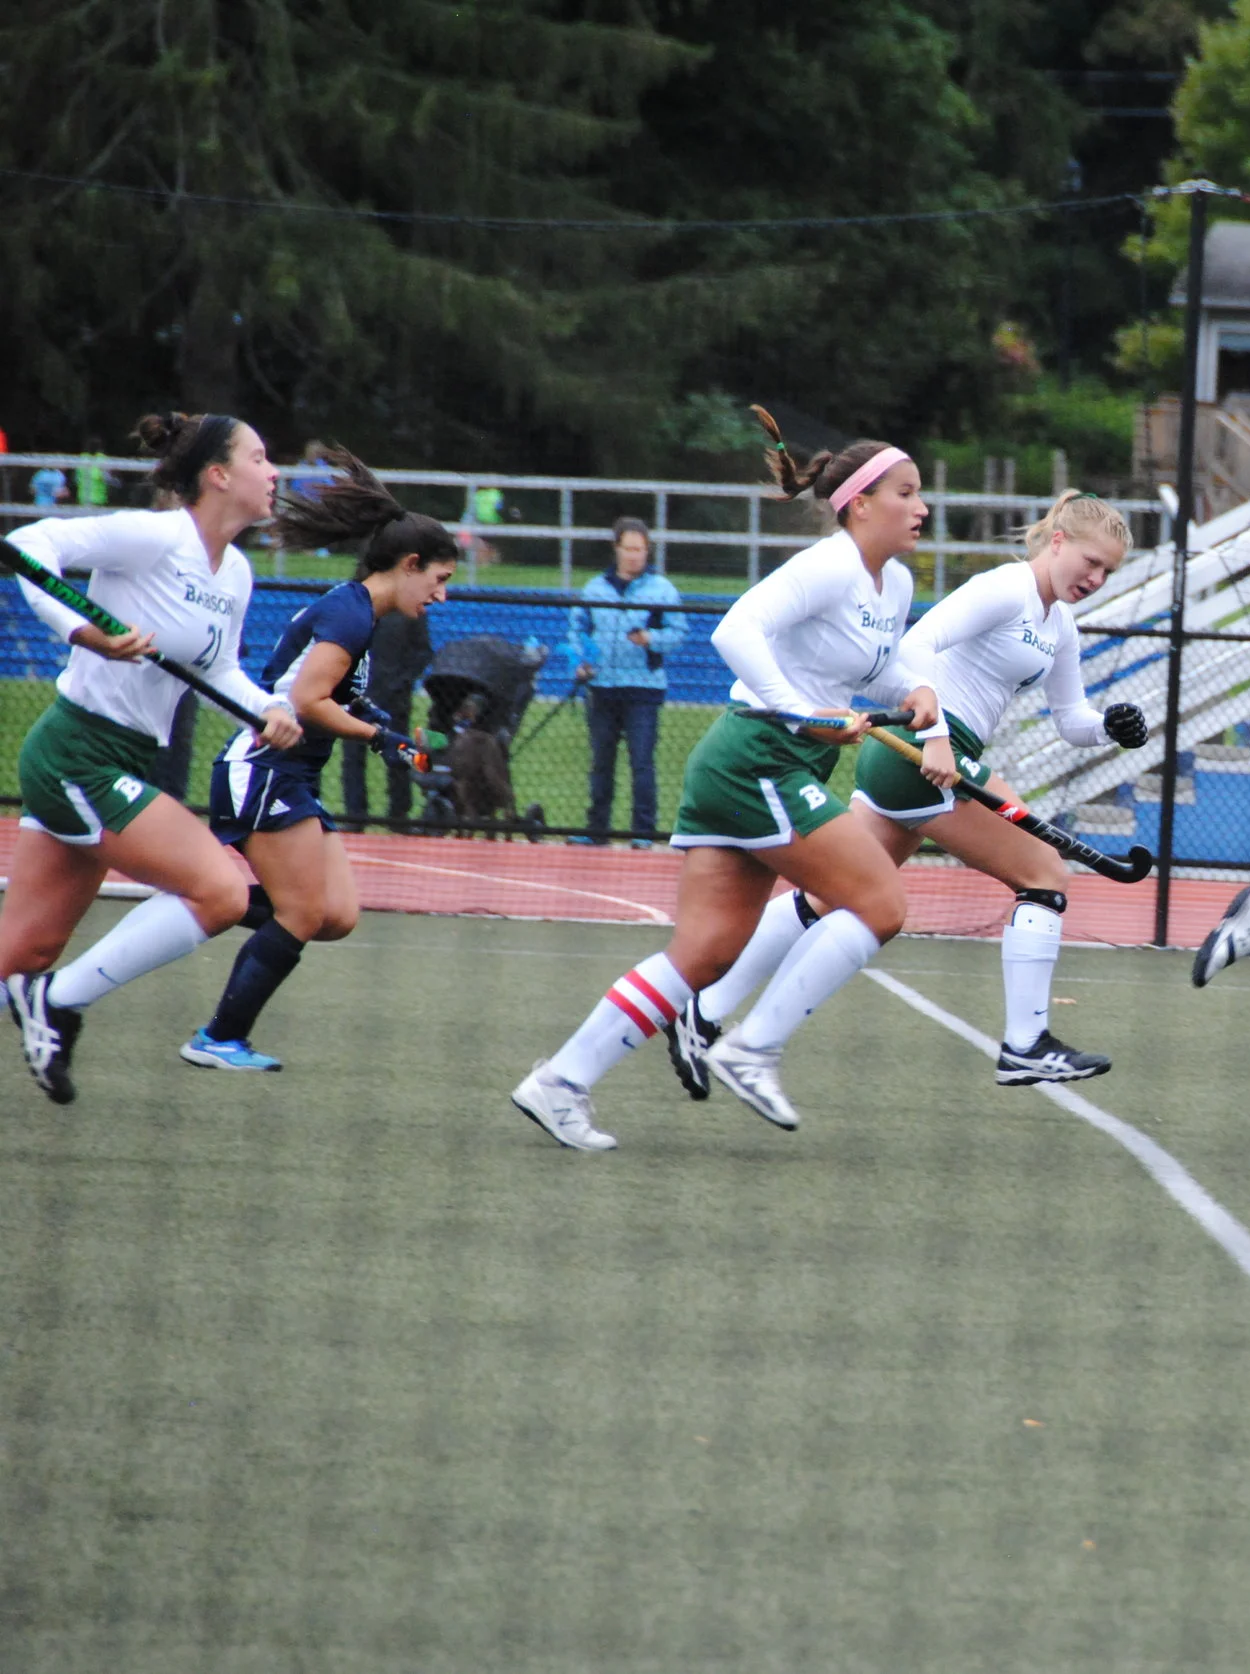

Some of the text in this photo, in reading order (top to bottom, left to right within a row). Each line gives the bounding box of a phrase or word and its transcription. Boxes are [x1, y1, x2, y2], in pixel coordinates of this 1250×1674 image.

[184, 584, 234, 616] BABSON
[960, 755, 981, 778] B
[112, 775, 143, 803] B
[799, 784, 827, 812] B
